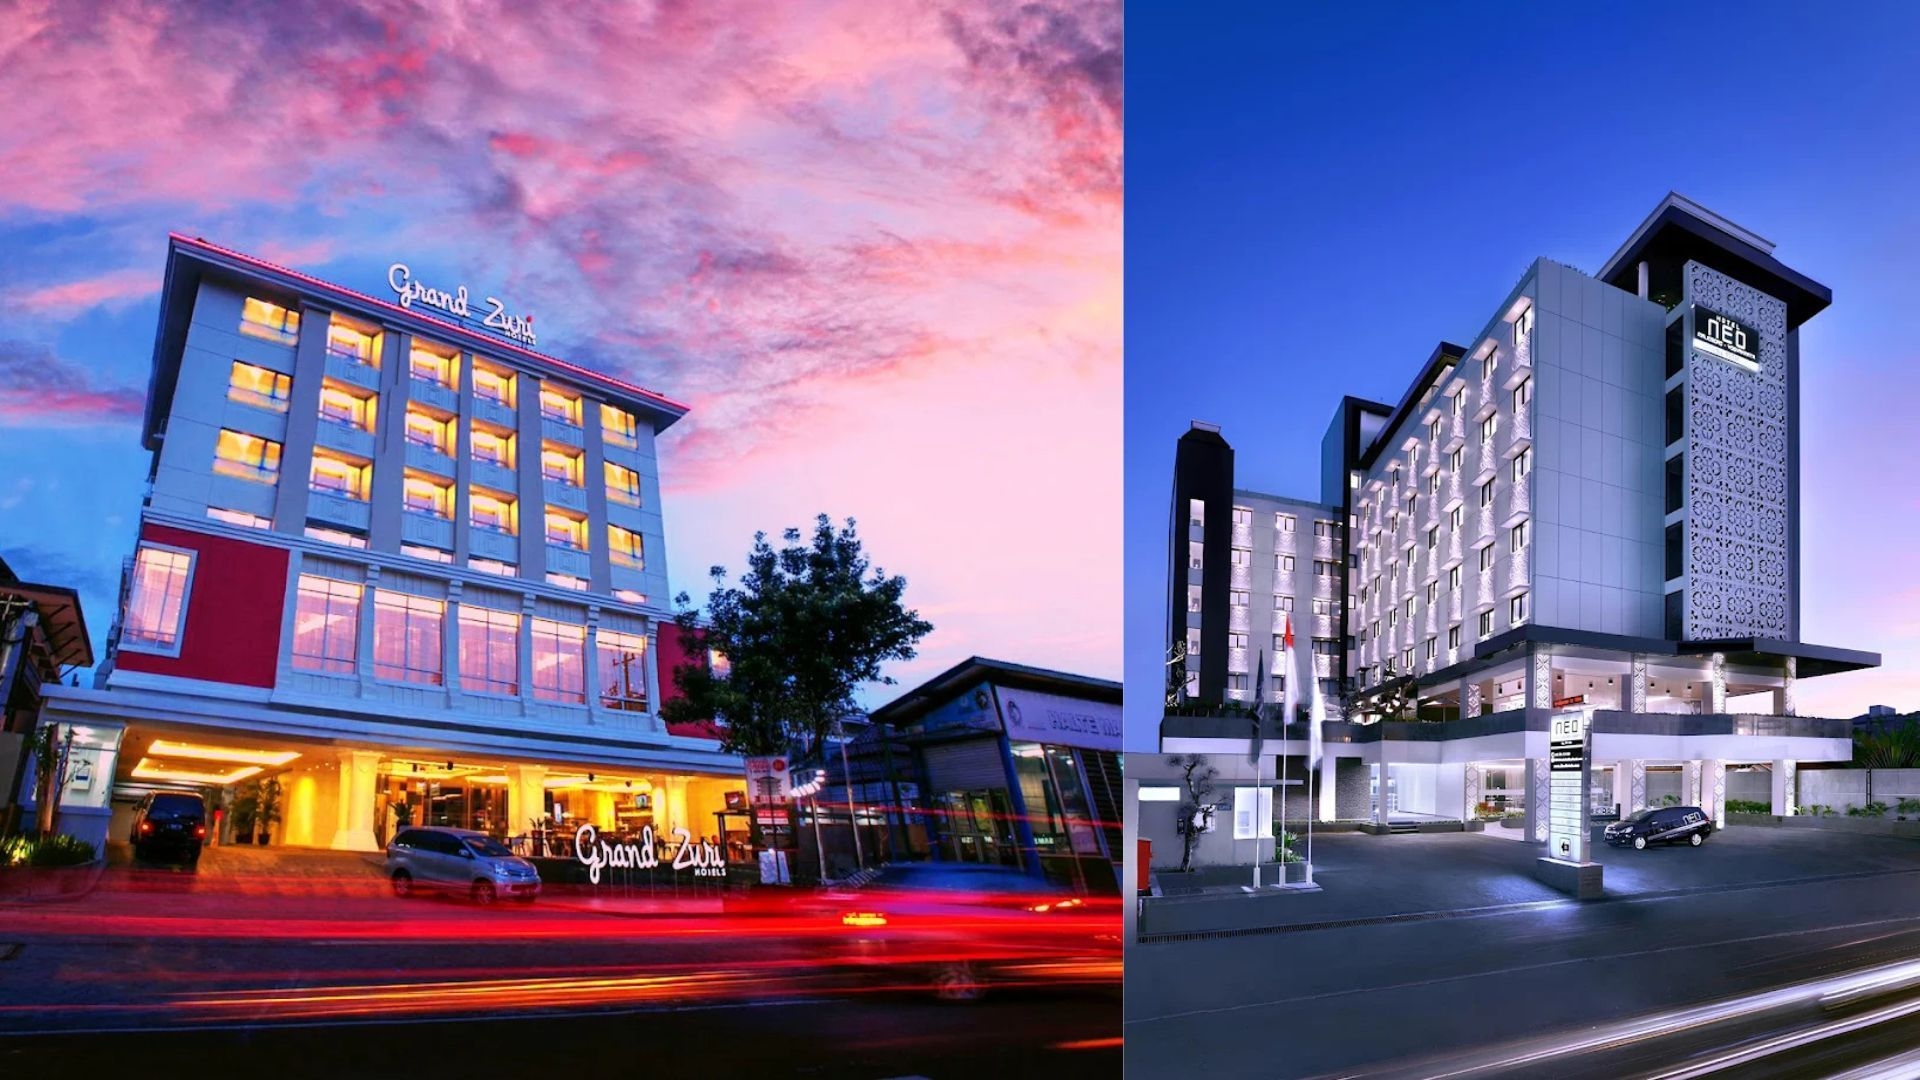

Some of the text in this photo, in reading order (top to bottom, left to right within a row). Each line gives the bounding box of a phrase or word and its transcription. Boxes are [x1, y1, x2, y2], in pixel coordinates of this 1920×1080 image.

[388, 263, 536, 339] Grand Zuri
[575, 823, 725, 885] Grand Zuri
[694, 867, 727, 877] HOTELS
